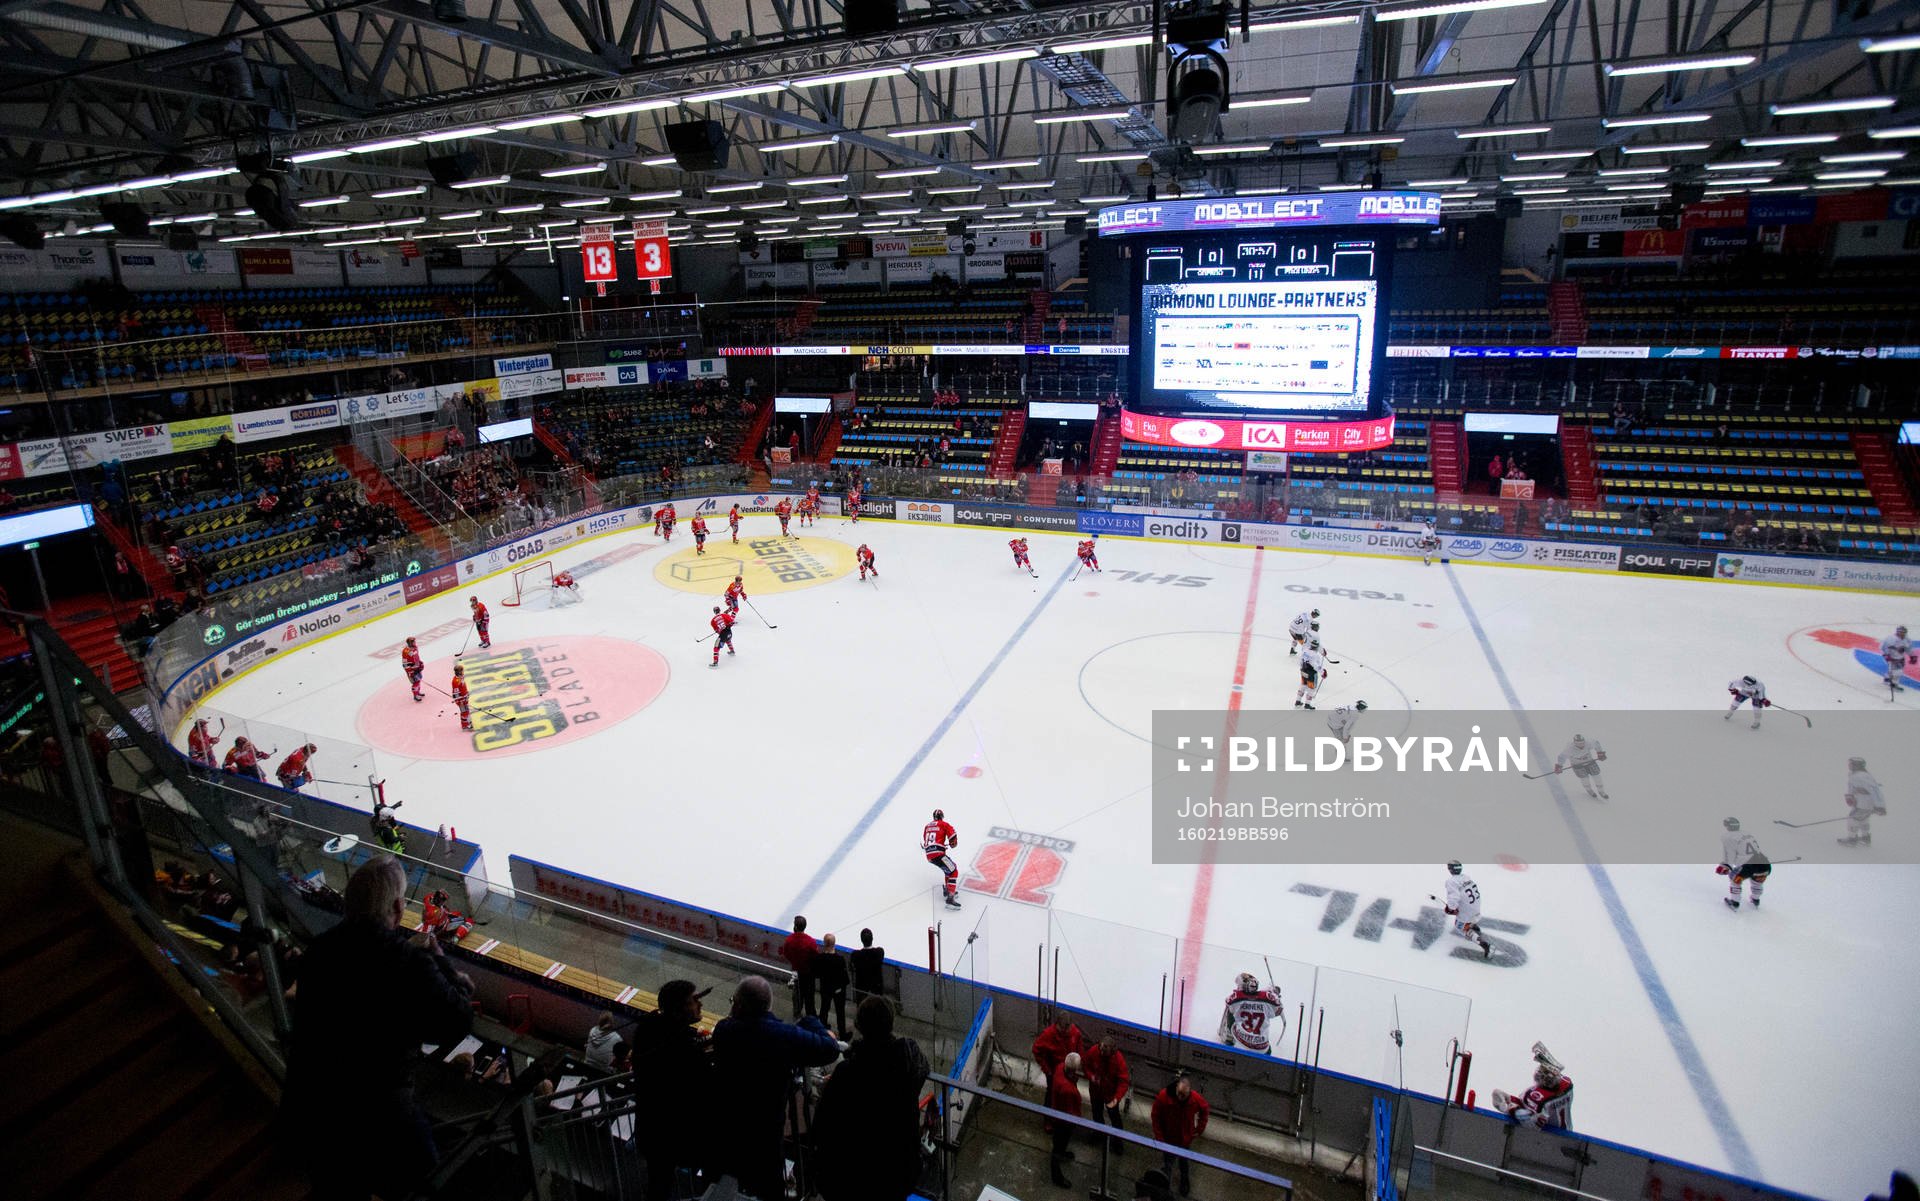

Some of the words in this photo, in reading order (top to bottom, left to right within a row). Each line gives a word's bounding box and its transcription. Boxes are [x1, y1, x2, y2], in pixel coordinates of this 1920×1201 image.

[1194, 199, 1323, 221] MOBILECT
[1581, 214, 1618, 222] BEIJER
[875, 243, 906, 251] SVEVIA
[50, 254, 95, 265] Thomas
[586, 246, 612, 275] 13
[644, 243, 662, 272] 3
[1208, 251, 1217, 262] 0
[1297, 249, 1307, 260] 0
[888, 261, 923, 269] HERCULES
[1218, 291, 1367, 308] LOUNGE-PARTNERS
[498, 358, 549, 372] Vintergatan
[242, 418, 285, 431] Lambertsson
[1248, 427, 1281, 444] ICA
[1294, 428, 1331, 441] Parken
[1343, 428, 1362, 441] City
[843, 500, 894, 515] hadlight
[589, 513, 627, 530] HOIST
[956, 510, 984, 520] SOUL
[1024, 516, 1076, 525] CONVENTUM
[1082, 515, 1141, 529] KLÖVERN
[1290, 527, 1363, 543] CONSENSUS
[507, 538, 545, 563] ÖBAB
[1449, 538, 1484, 550] MOAB
[1489, 541, 1525, 553] MOAB
[1554, 548, 1617, 561] PISCATOR
[1624, 554, 1666, 567] SOUL
[236, 619, 253, 632] Gör
[254, 613, 275, 625] som
[276, 602, 307, 619] Örebro
[308, 590, 340, 609] hockey
[346, 581, 369, 595] träna
[299, 612, 342, 636] Nolato
[1464, 888, 1480, 905] 33
[1240, 1011, 1266, 1035] 37
